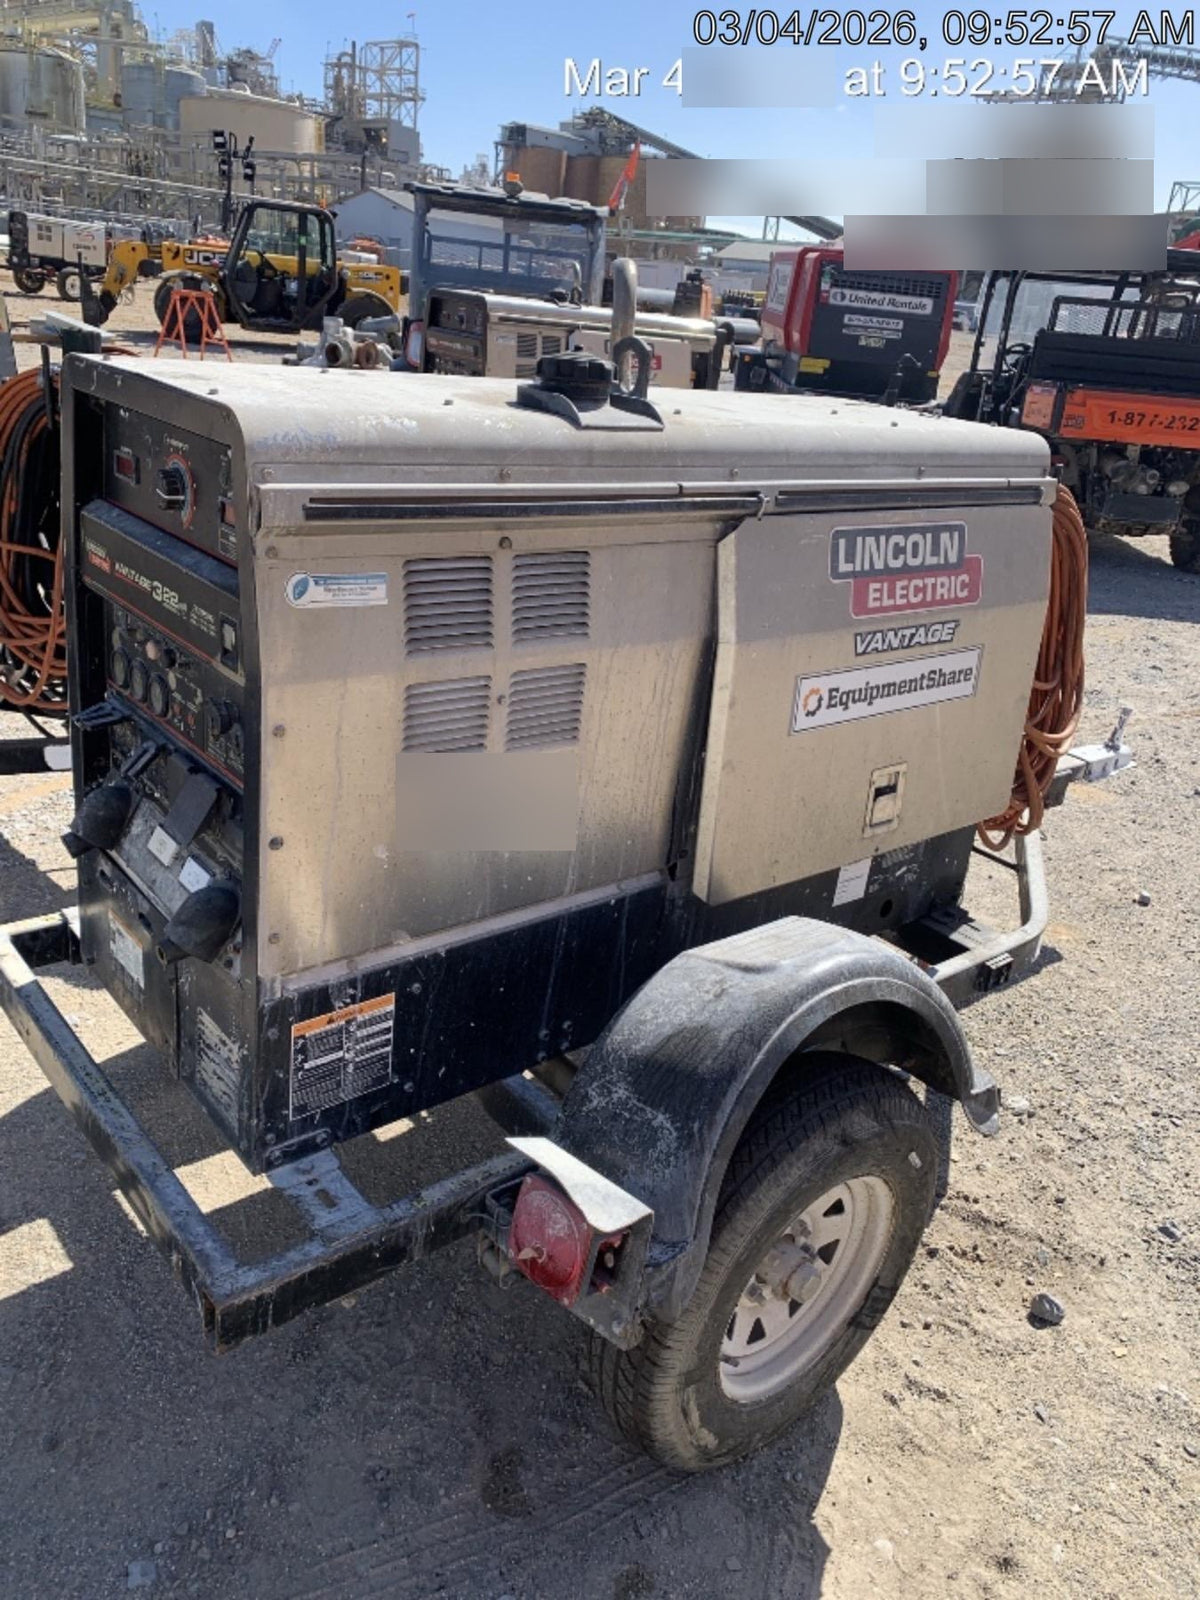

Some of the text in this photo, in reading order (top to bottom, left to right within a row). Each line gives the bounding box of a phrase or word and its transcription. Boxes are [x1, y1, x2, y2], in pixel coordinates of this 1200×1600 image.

[848, 293, 928, 311] United Rentals
[838, 531, 959, 573] LINCOLN
[867, 573, 970, 609] ELECTRIC
[855, 621, 957, 655] VANTAGE
[826, 666, 973, 711] EquipmentShare
